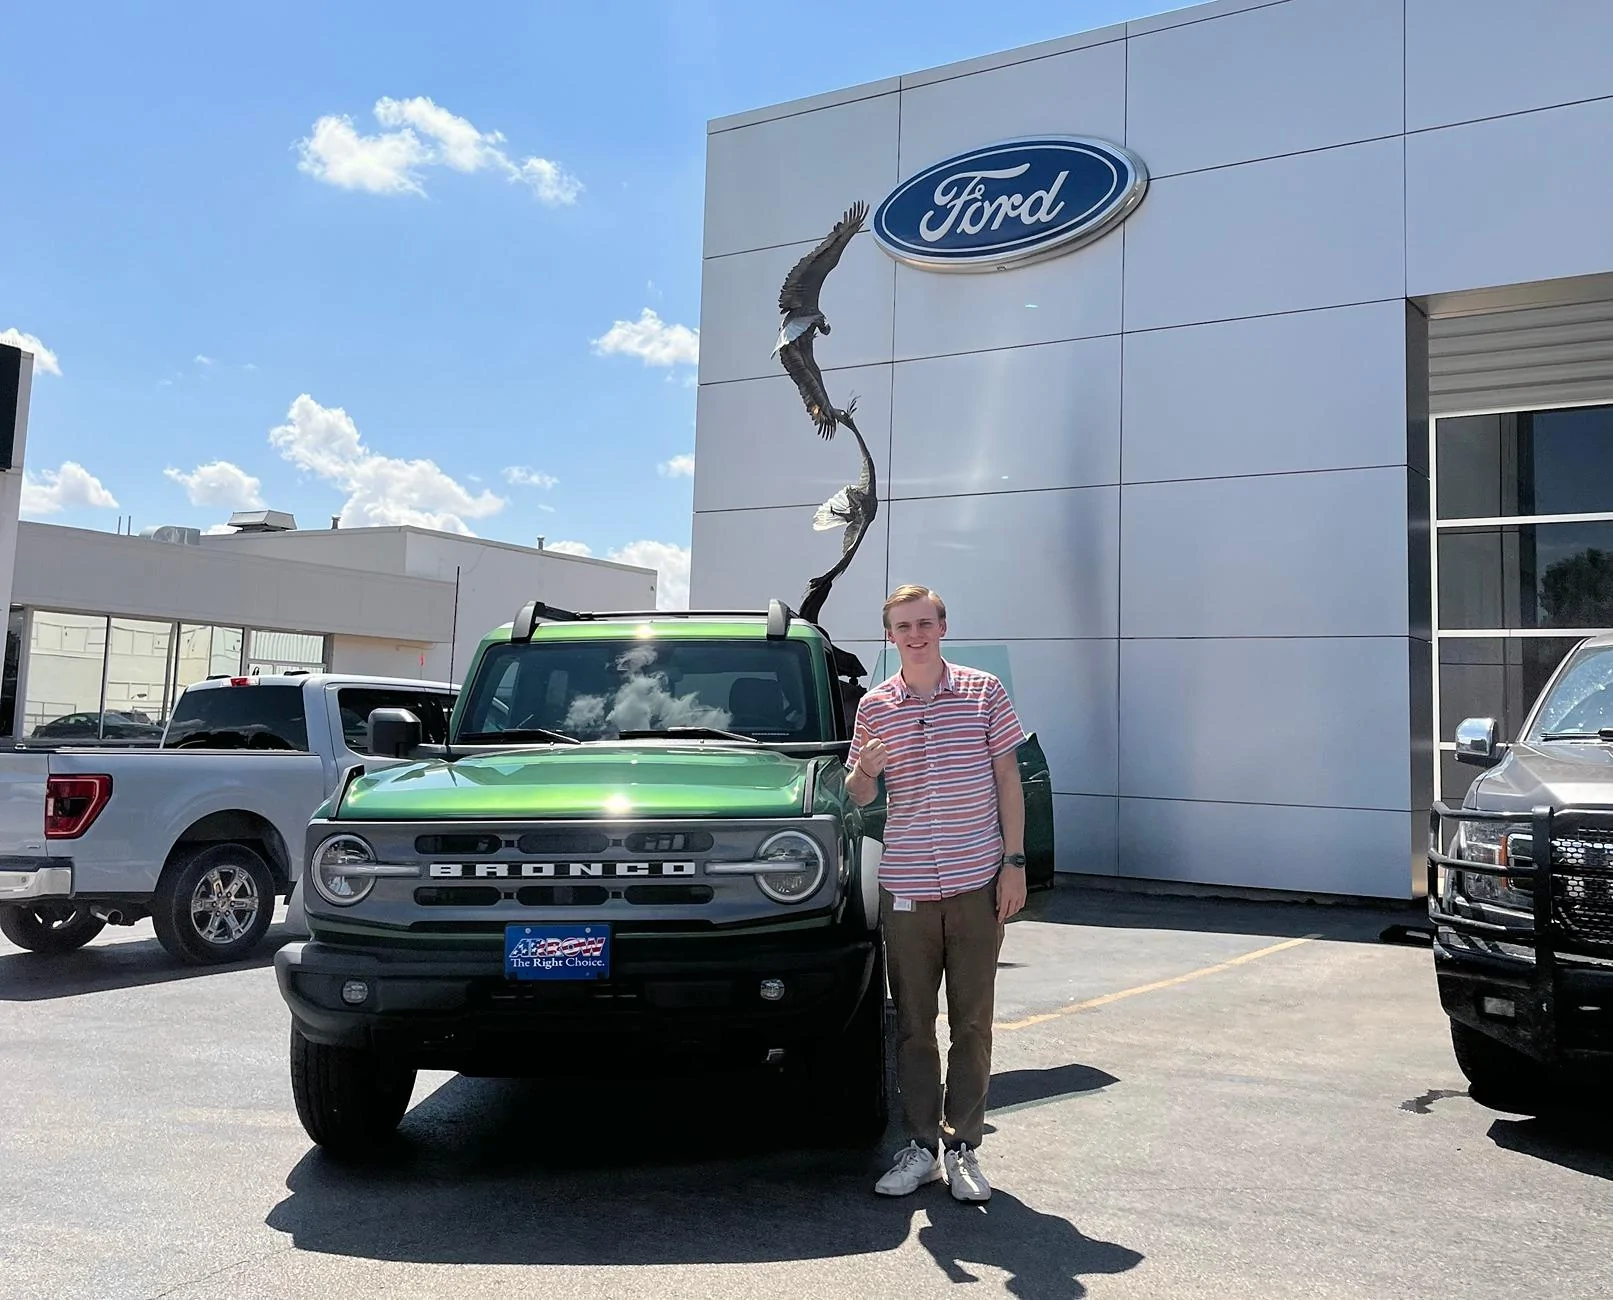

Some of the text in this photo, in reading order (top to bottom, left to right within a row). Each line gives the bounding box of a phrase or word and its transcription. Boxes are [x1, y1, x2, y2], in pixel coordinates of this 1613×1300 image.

[919, 162, 1070, 242] Ford
[429, 861, 696, 877] BRONCO
[508, 936, 606, 957] ARROW
[510, 957, 606, 970] The Right Choice.
